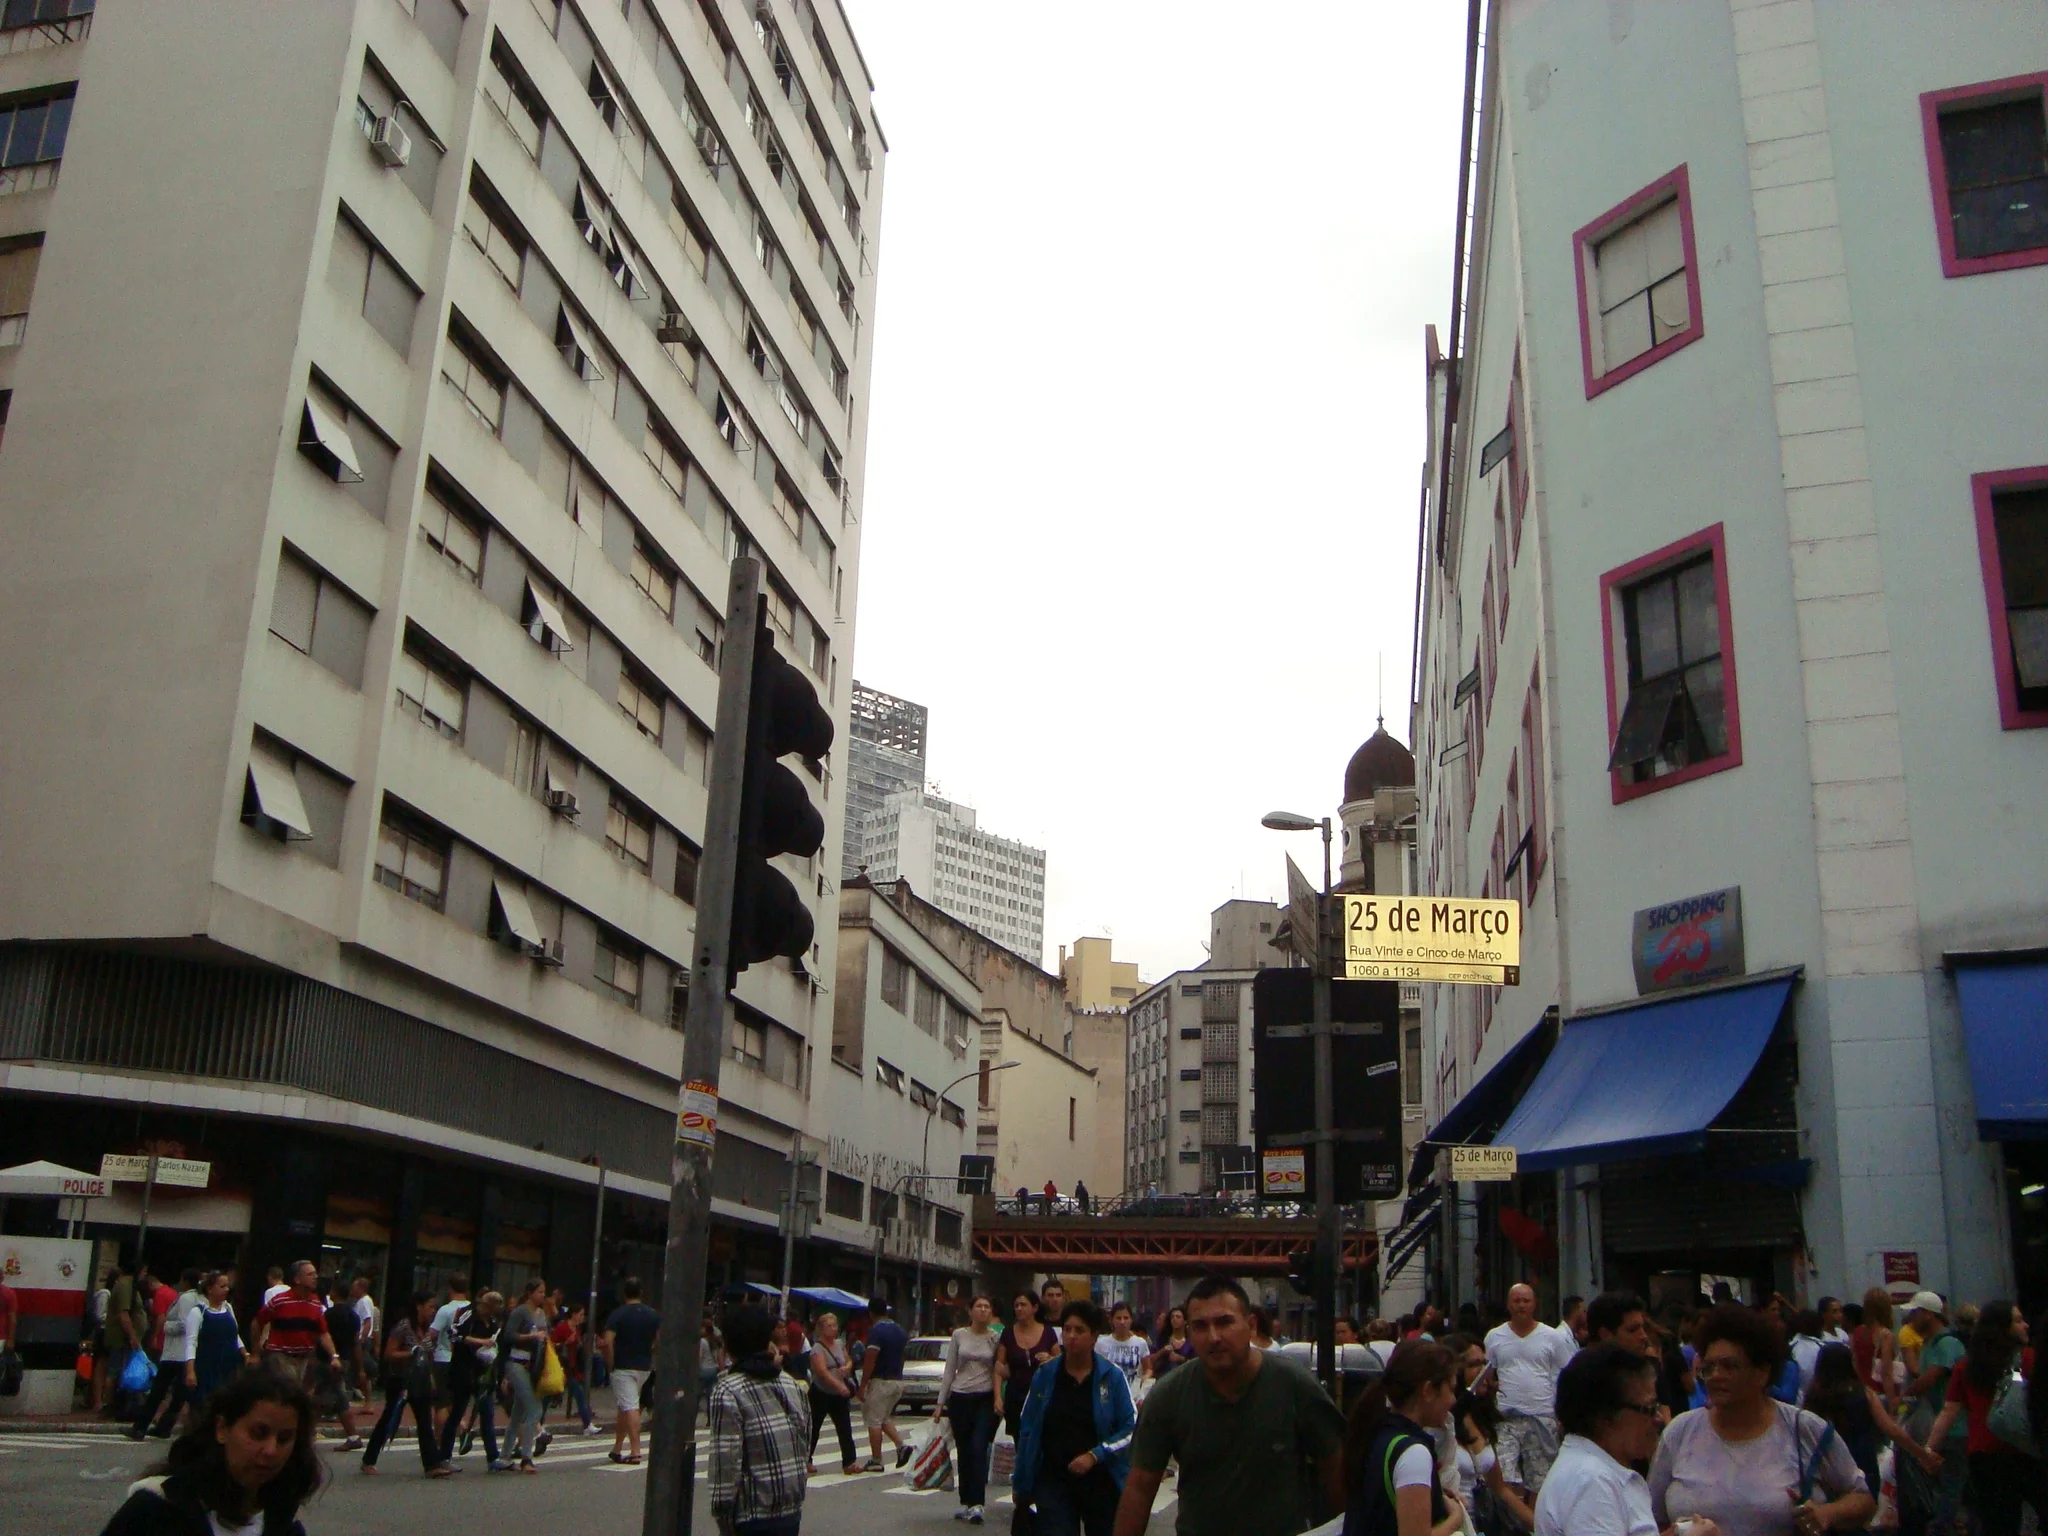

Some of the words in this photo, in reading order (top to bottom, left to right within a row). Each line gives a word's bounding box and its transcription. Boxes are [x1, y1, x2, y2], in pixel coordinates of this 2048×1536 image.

[1648, 893, 1726, 931] SHOPPING
[1350, 901, 1378, 931] 25
[1389, 900, 1420, 932] de
[1431, 903, 1509, 943] Março
[1350, 945, 1371, 956] Rua
[1375, 945, 1404, 957] Vinte
[1406, 948, 1413, 956] e
[1416, 946, 1448, 958] Cinco
[1451, 947, 1465, 959] de
[1468, 949, 1502, 962] Março
[1653, 910, 1716, 984] 25
[1353, 965, 1379, 976] 1060
[1383, 967, 1390, 976] a
[1394, 966, 1420, 977] 1134
[1510, 973, 1515, 983] 1
[104, 1156, 114, 1166] 25
[116, 1156, 126, 1167] de
[158, 1160, 180, 1169] Carlos
[1454, 1149, 1466, 1162] 25
[1468, 1149, 1480, 1162] de
[1483, 1149, 1513, 1165] Março
[64, 1179, 104, 1195] POLICE
